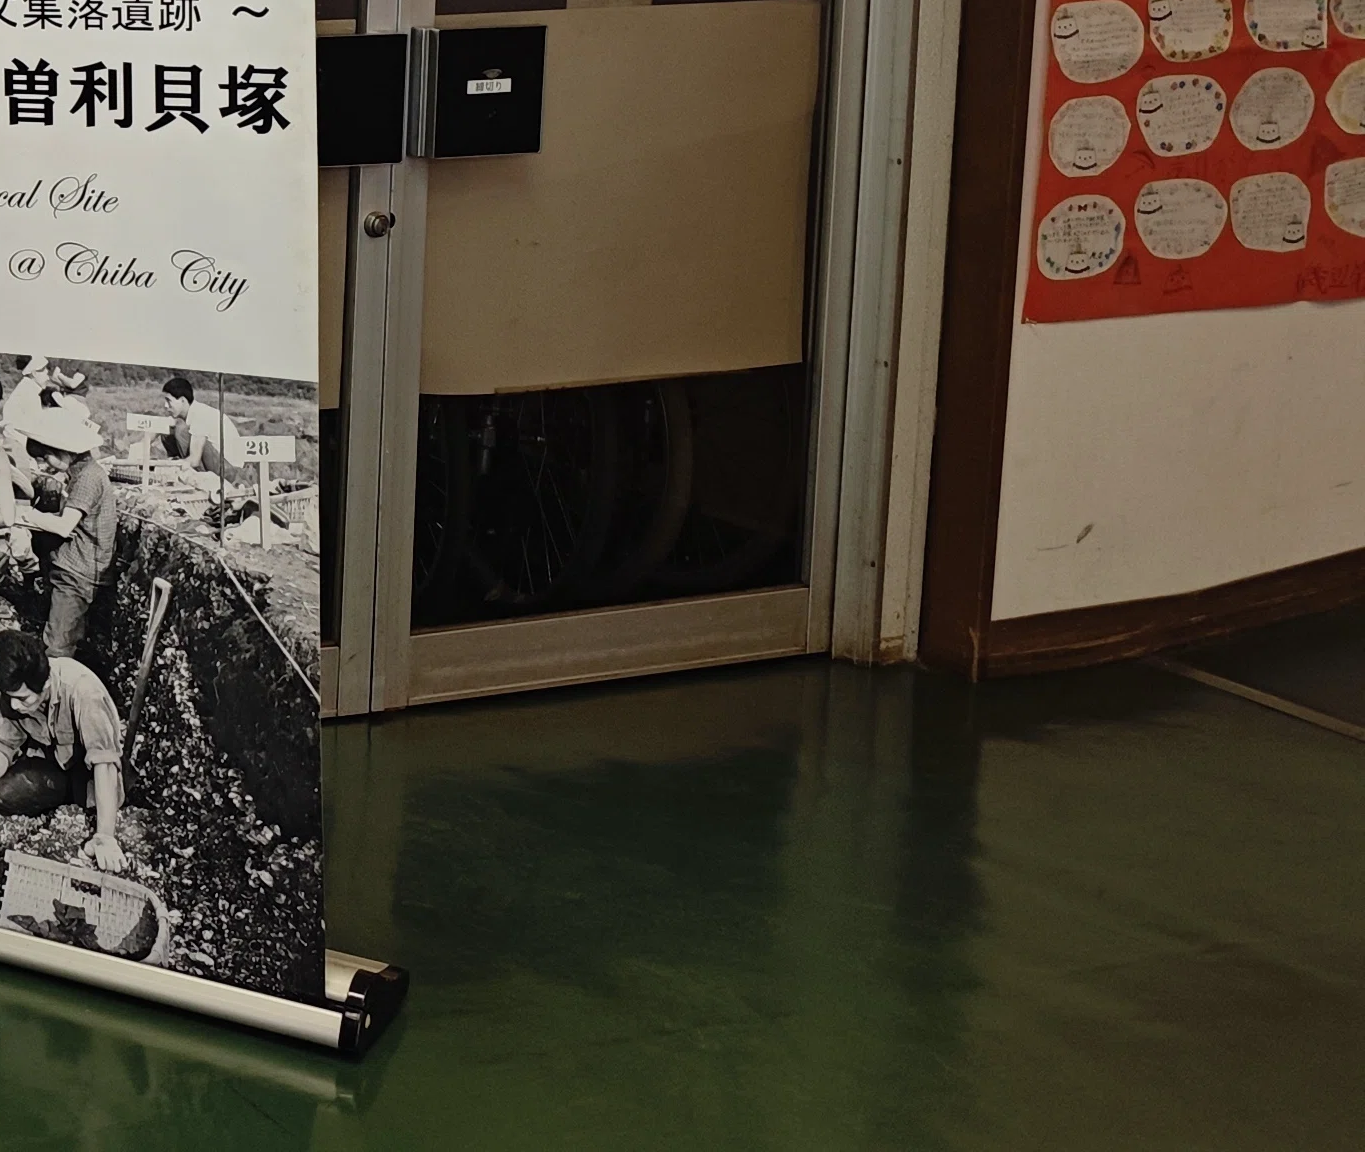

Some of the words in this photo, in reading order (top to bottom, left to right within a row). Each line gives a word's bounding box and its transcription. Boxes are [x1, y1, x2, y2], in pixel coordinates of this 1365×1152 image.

[49, 173, 120, 219] Site
[8, 249, 45, 281] @
[55, 242, 157, 288] Chiba
[171, 249, 250, 312] City
[246, 440, 269, 456] 28
